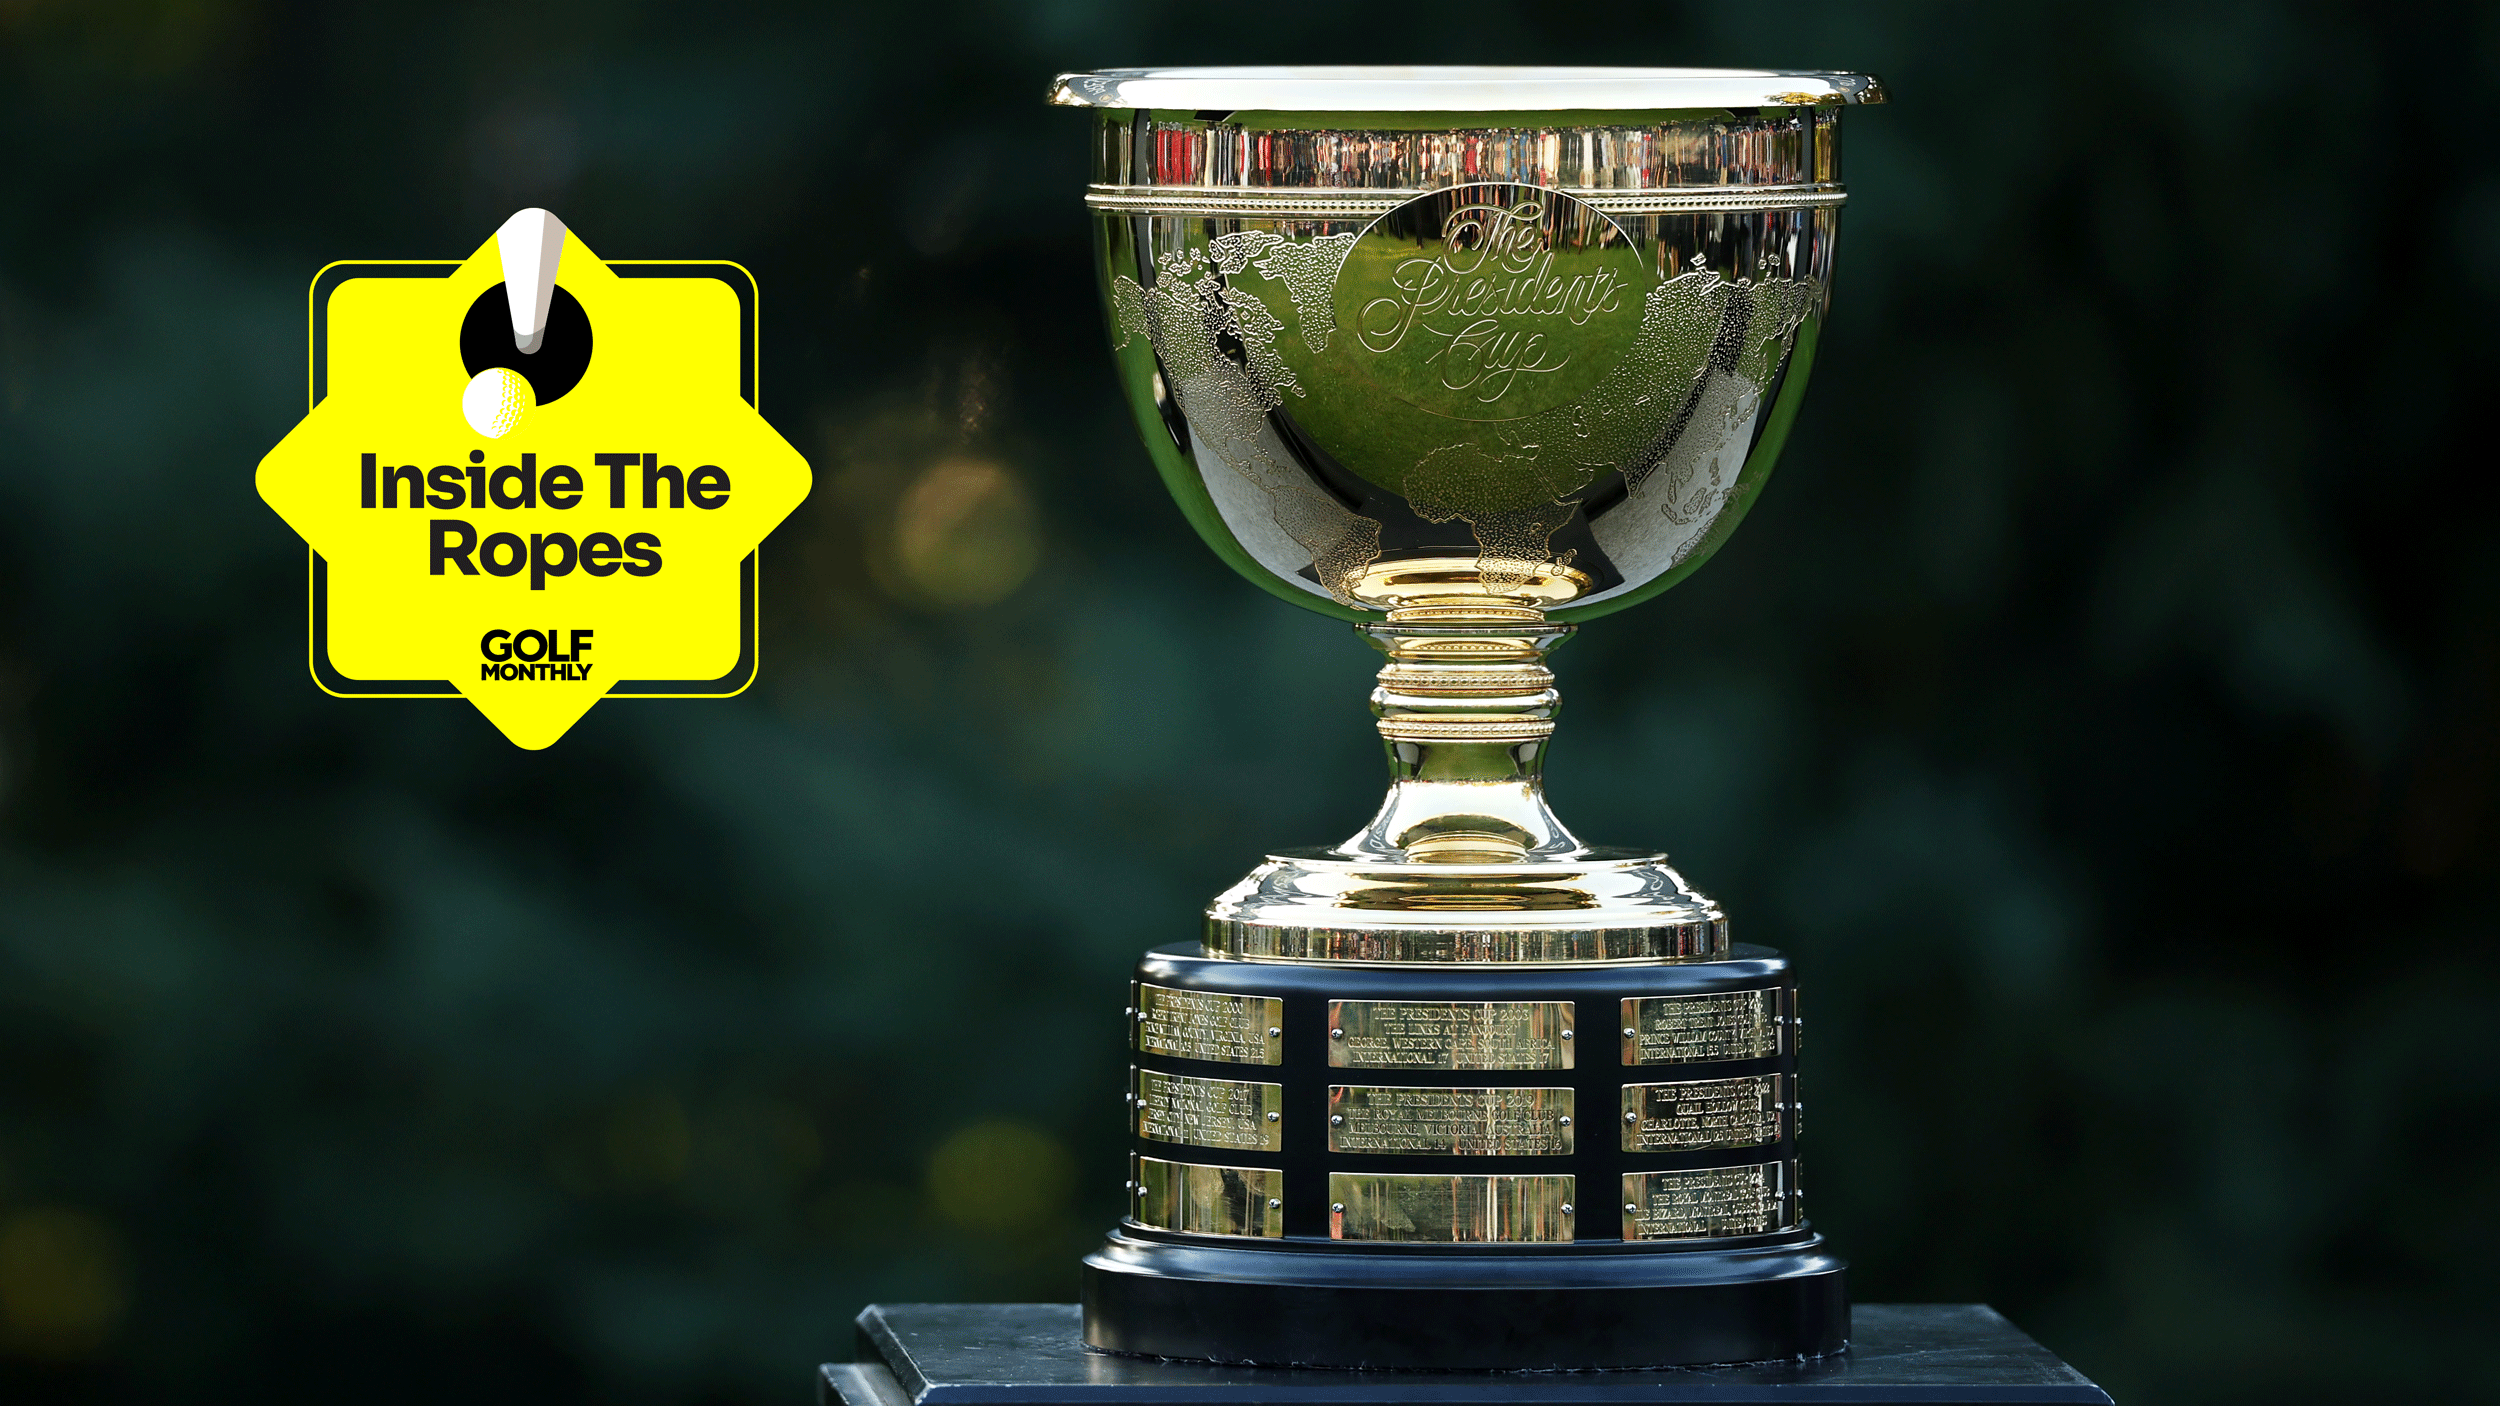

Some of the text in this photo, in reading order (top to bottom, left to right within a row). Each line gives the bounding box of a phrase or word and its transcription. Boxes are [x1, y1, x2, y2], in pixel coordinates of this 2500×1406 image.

[1441, 199, 1545, 275] The
[1357, 250, 1628, 353] Presidents
[1424, 318, 1571, 403] Cup
[1222, 1001, 1244, 1015] 2000
[1373, 1007, 1530, 1021] THE PRESIDENTS CUP 2003
[1383, 1023, 1518, 1037] THE LINKS AT FANCOURT
[1348, 1037, 1390, 1050] GEORGE,
[1392, 1037, 1443, 1050] WESTERN
[1477, 1038, 1513, 1050] SOUTH
[1516, 1038, 1556, 1050] AFRICA
[1639, 1033, 1670, 1046] PRINCE
[1221, 1045, 1249, 1058] STATES
[1352, 1052, 1436, 1064] INTERNATIONAL
[1437, 1053, 1449, 1065] 17
[1456, 1053, 1496, 1065] UNITED
[1498, 1053, 1537, 1065] STATES
[1640, 1045, 1706, 1060] INTERNATIONAL
[1227, 1088, 1250, 1101] 2017
[1367, 1092, 1392, 1106] THE
[1396, 1093, 1474, 1107] PRESIDENTS
[1477, 1094, 1502, 1108] CUP
[1655, 1088, 1678, 1102] THE
[1679, 1085, 1736, 1101] PRESIDENTS
[1228, 1103, 1253, 1116] CLUB
[1348, 1108, 1555, 1123] THE ROYAL MELBOURNE GOLF CLUB
[1676, 1102, 1704, 1116] QUAIL
[1705, 1100, 1738, 1114] HOLLOW
[1237, 1118, 1257, 1131] USA
[1348, 1122, 1421, 1137] MELBOURNE,
[1485, 1124, 1554, 1137] AUSTRALIA
[1641, 1117, 1700, 1132] CHARLOTTE,
[1701, 1115, 1729, 1128] NORTH
[1224, 1131, 1258, 1145] STATES
[1339, 1136, 1563, 1151] INTERNATIONAL 14 UNITED STATES 16
[1636, 1130, 1712, 1145] INTERNATIONAL
[1638, 1221, 1707, 1236] INTERNATIONAL
